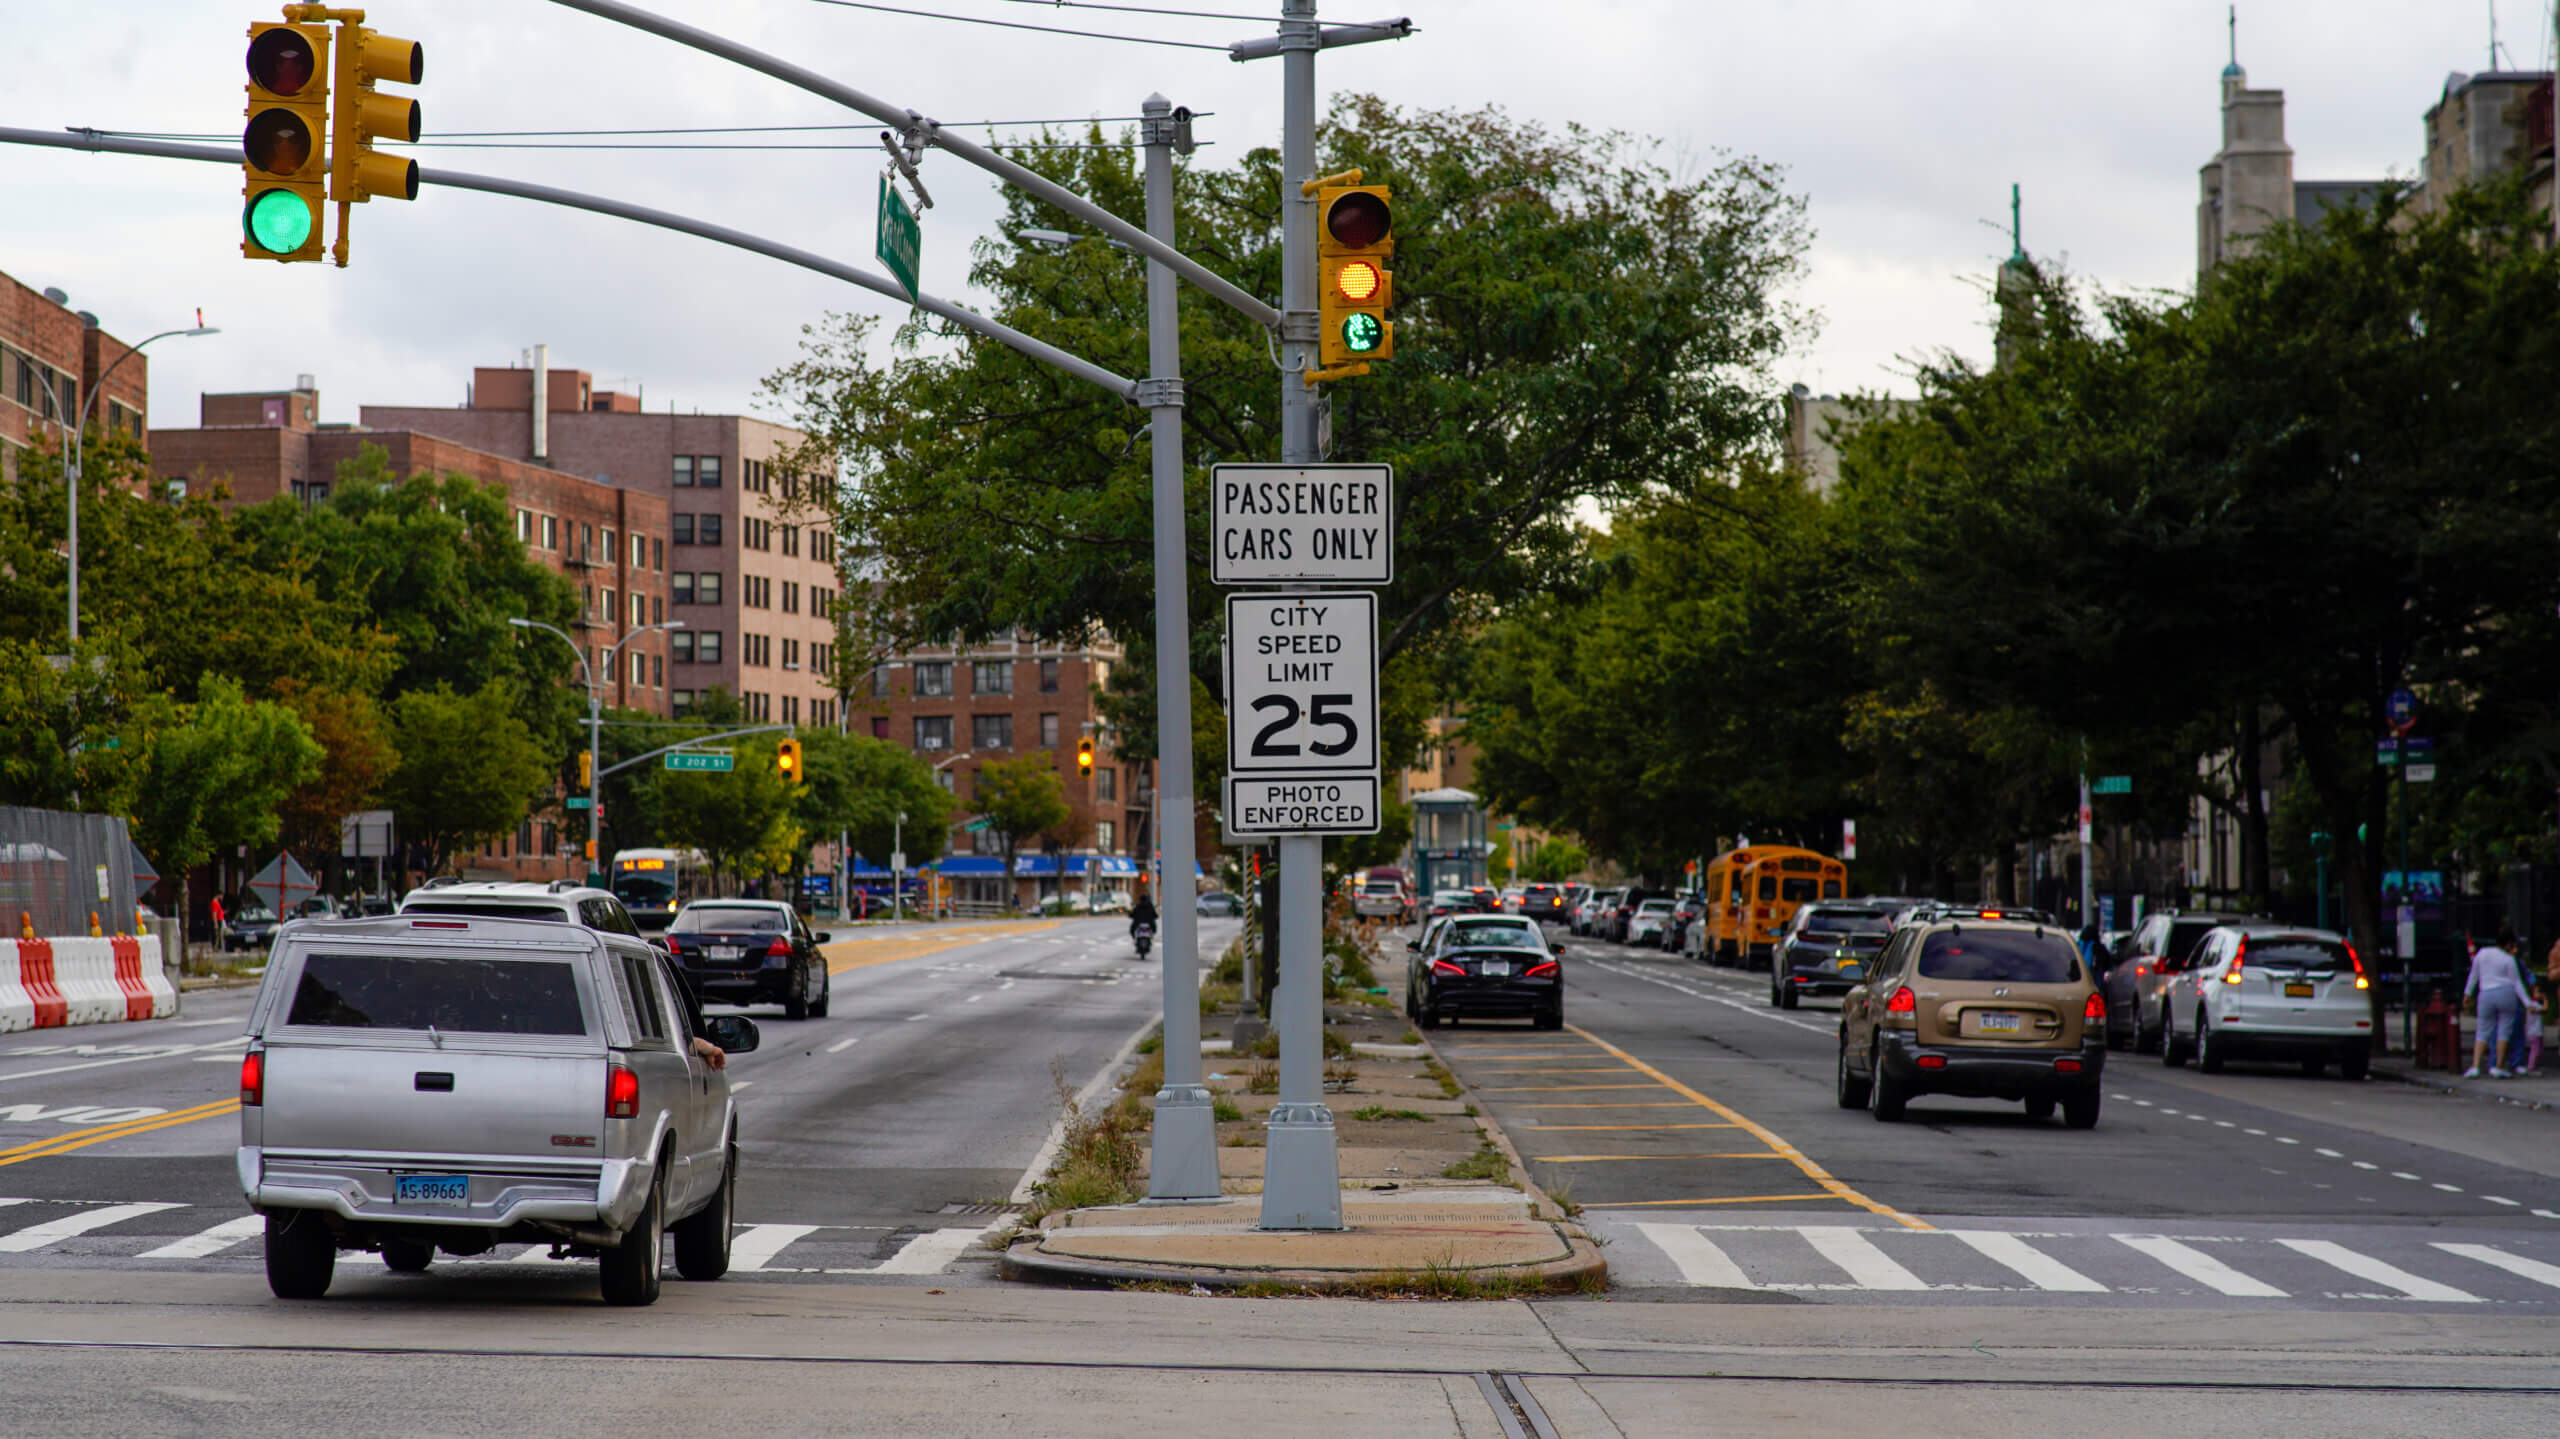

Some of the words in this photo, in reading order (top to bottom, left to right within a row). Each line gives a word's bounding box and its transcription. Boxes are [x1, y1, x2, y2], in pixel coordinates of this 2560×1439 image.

[1225, 482, 1378, 515] PASSENGER
[1224, 527, 1293, 561] CARS
[1312, 527, 1379, 561] ONLY
[1270, 606, 1328, 627] CITY
[1258, 634, 1342, 655] SPEED
[1267, 662, 1334, 683] LIMIT
[1250, 693, 1358, 757] 25
[687, 757, 707, 767] 202
[1267, 785, 1341, 803] PHOTO
[1244, 806, 1364, 824] ENFORCED
[400, 1183, 466, 1200] AS-89663
